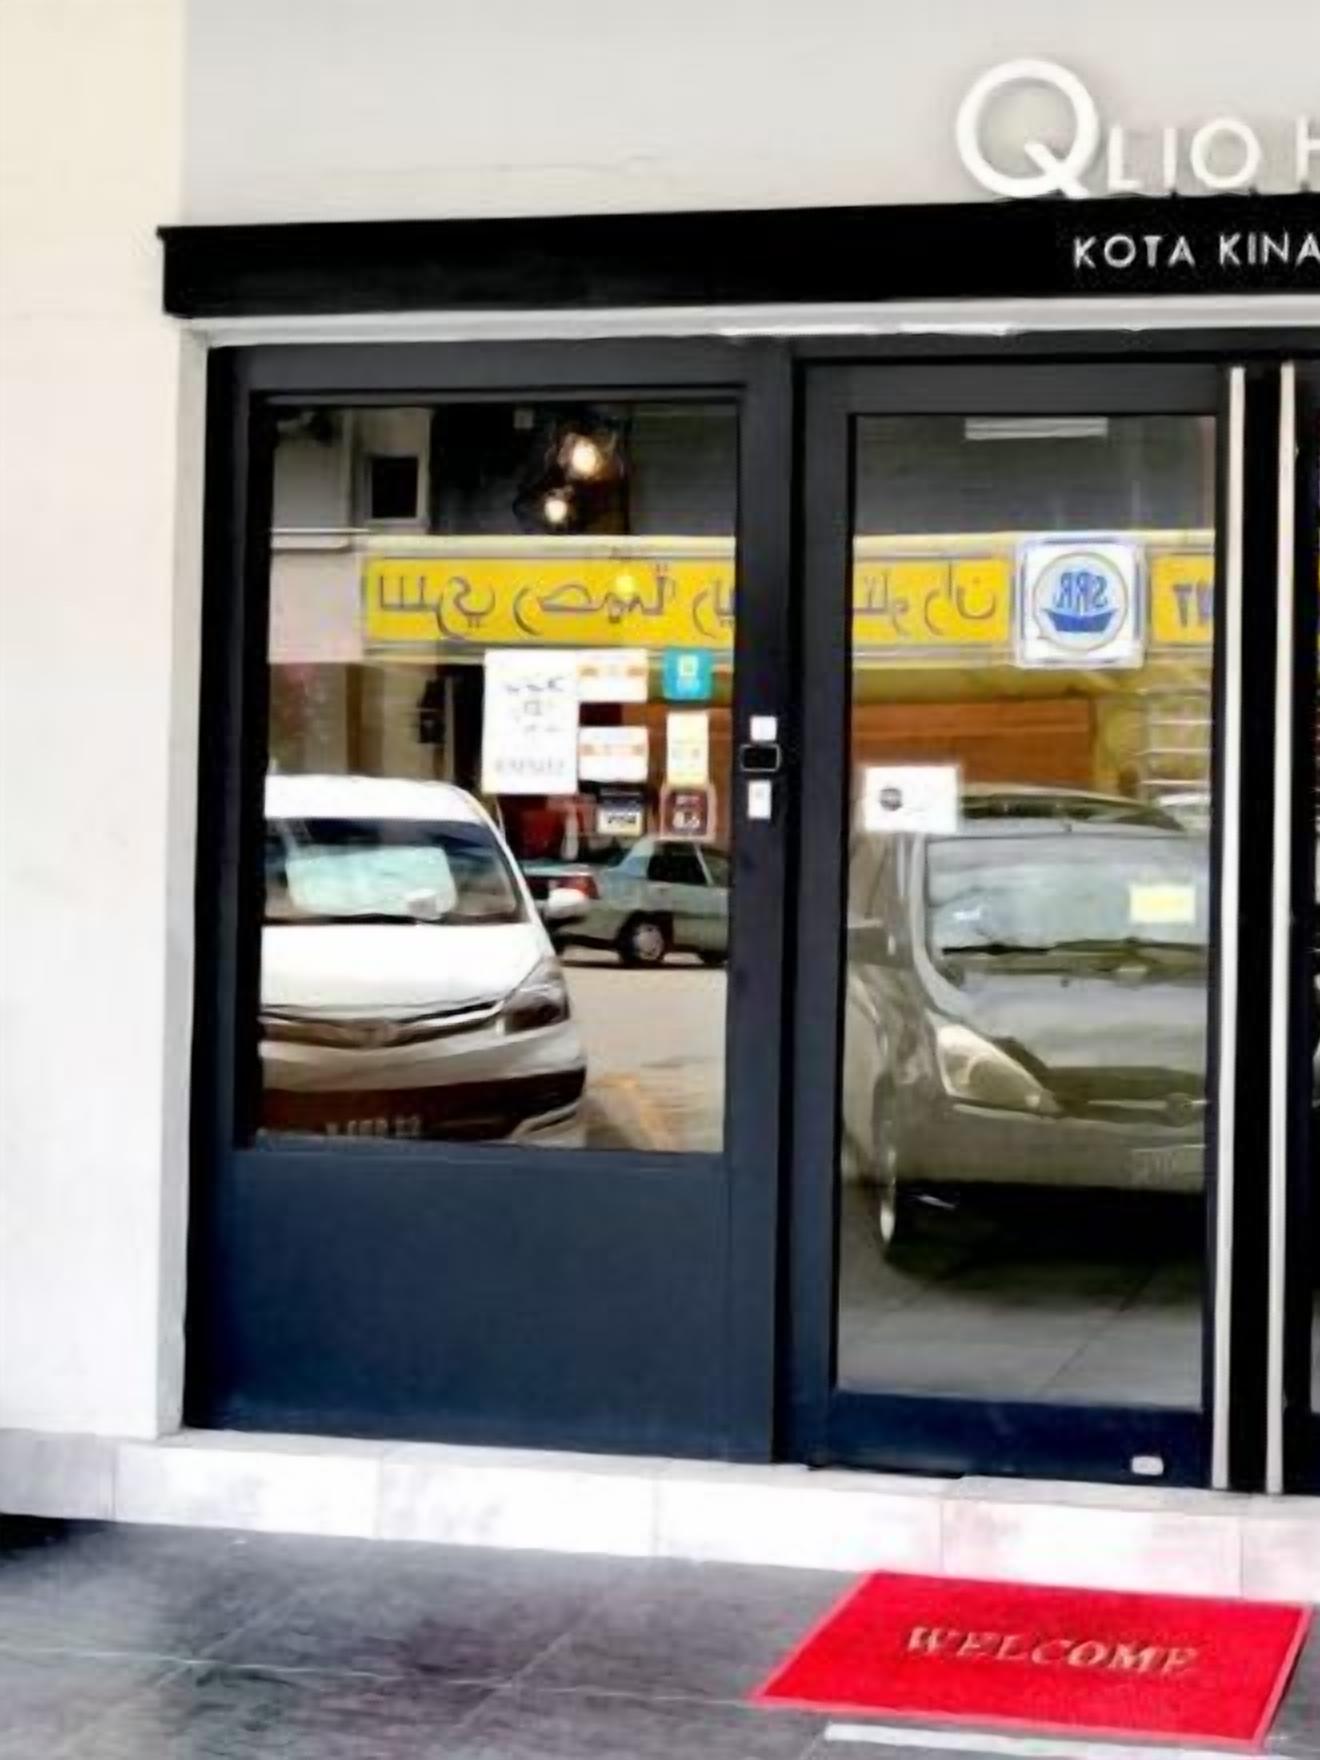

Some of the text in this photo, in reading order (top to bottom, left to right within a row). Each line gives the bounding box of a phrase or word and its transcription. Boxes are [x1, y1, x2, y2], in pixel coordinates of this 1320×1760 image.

[956, 58, 1261, 199] QLIO
[1073, 232, 1196, 270] KOTA
[905, 1624, 1200, 1676] WELCOME
